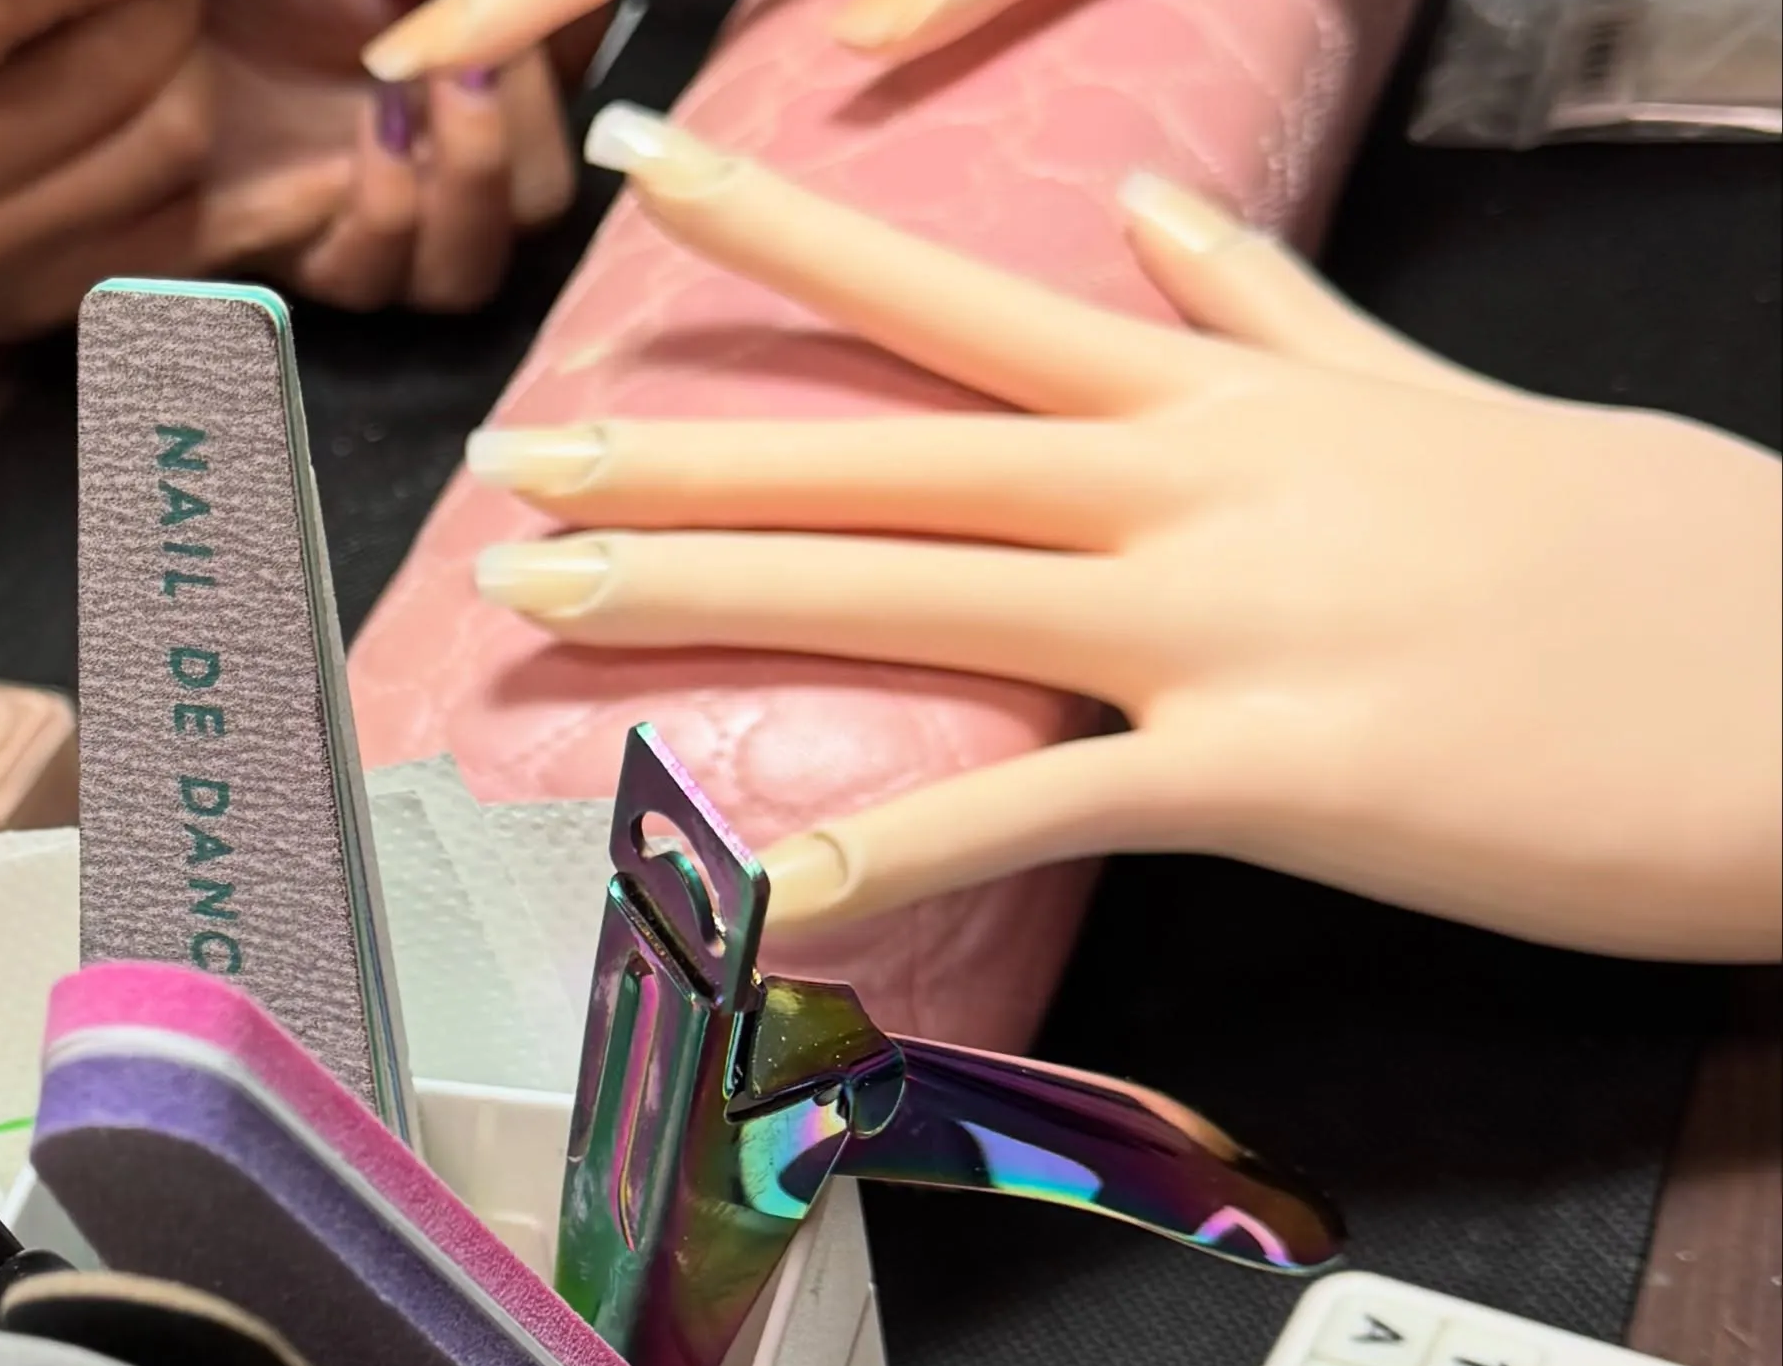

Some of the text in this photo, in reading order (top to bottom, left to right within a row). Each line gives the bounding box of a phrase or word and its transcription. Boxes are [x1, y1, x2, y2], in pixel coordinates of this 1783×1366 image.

[155, 423, 217, 598] NAIL
[167, 646, 226, 736] DE
[1350, 1313, 1405, 1353] A
